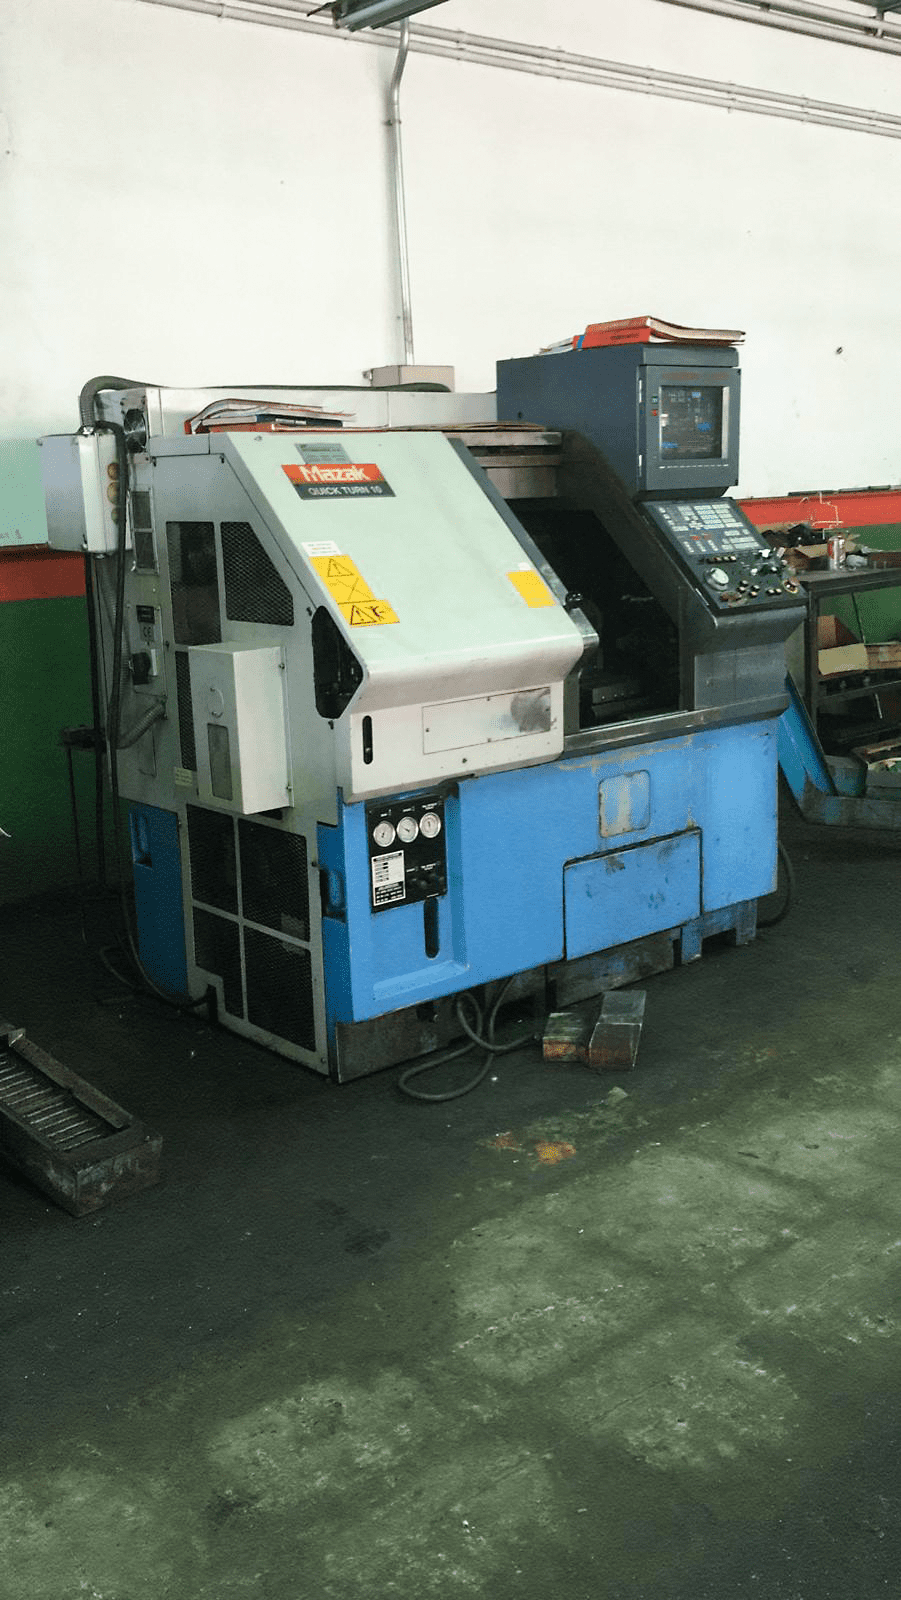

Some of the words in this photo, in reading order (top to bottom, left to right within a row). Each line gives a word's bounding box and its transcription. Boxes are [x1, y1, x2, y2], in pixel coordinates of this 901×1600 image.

[298, 464, 371, 482] Mazak
[308, 486, 342, 496] QUICK
[341, 486, 370, 495] TURN
